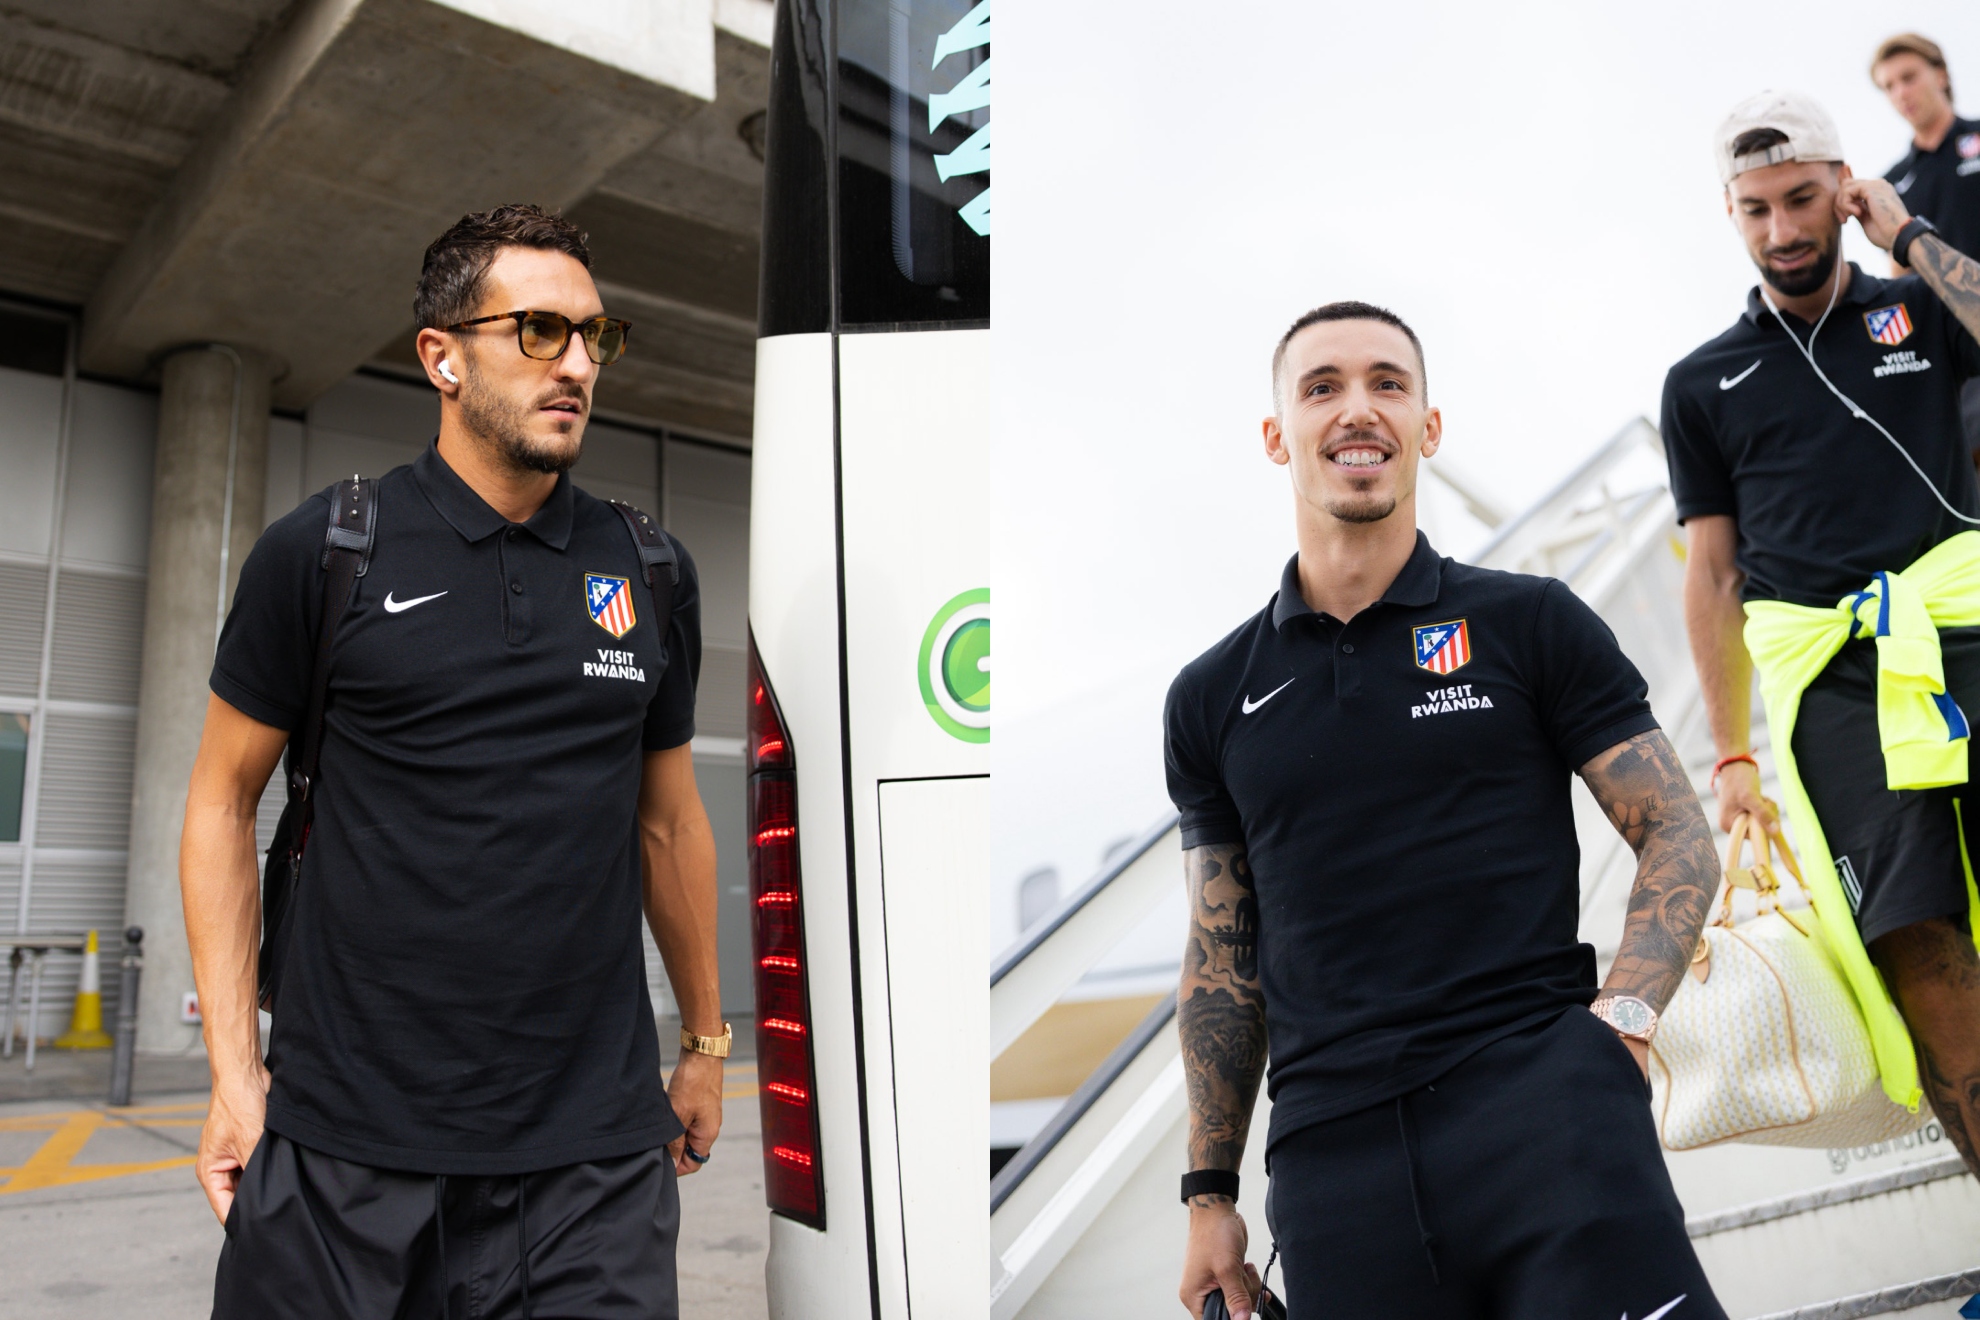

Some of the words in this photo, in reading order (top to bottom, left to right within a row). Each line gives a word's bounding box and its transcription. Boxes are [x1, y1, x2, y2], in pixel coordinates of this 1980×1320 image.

[1882, 350, 1916, 365] VISIT
[1873, 358, 1932, 378] RWANDA
[597, 648, 634, 666] VISIT
[583, 662, 646, 682] RWANDA
[1426, 684, 1472, 702] VISIT
[1411, 695, 1494, 719] RWANDA
